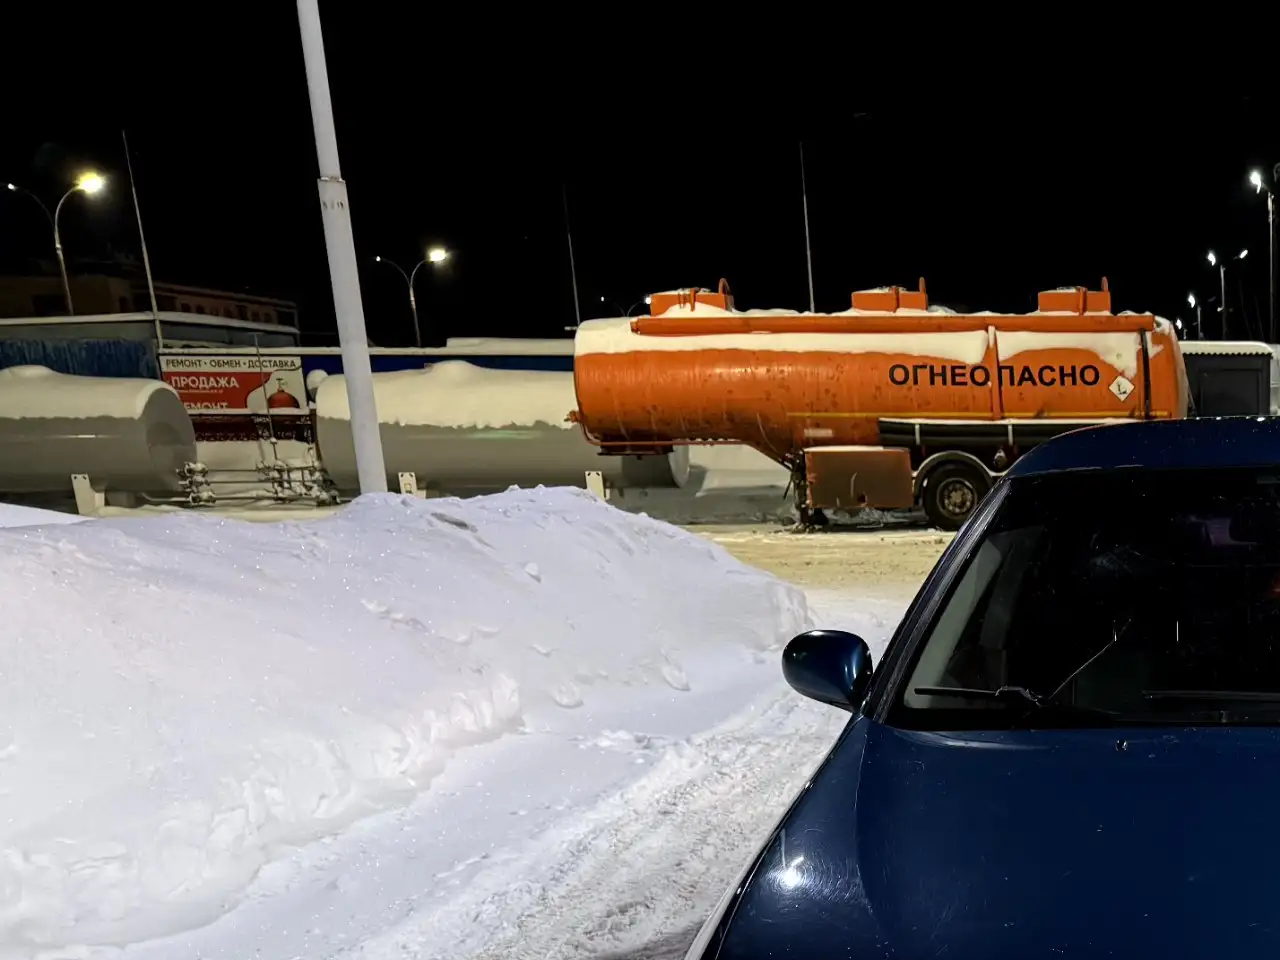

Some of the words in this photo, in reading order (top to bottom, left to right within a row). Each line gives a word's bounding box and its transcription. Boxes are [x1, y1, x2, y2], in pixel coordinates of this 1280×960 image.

[165, 359, 202, 368] РЕМОНТ
[209, 359, 241, 368] ОБМЕН
[247, 359, 297, 369] ДОСТАВКА
[888, 363, 1101, 388] ОГНЕОПАСНО
[171, 376, 240, 389] ПРОДАЖА
